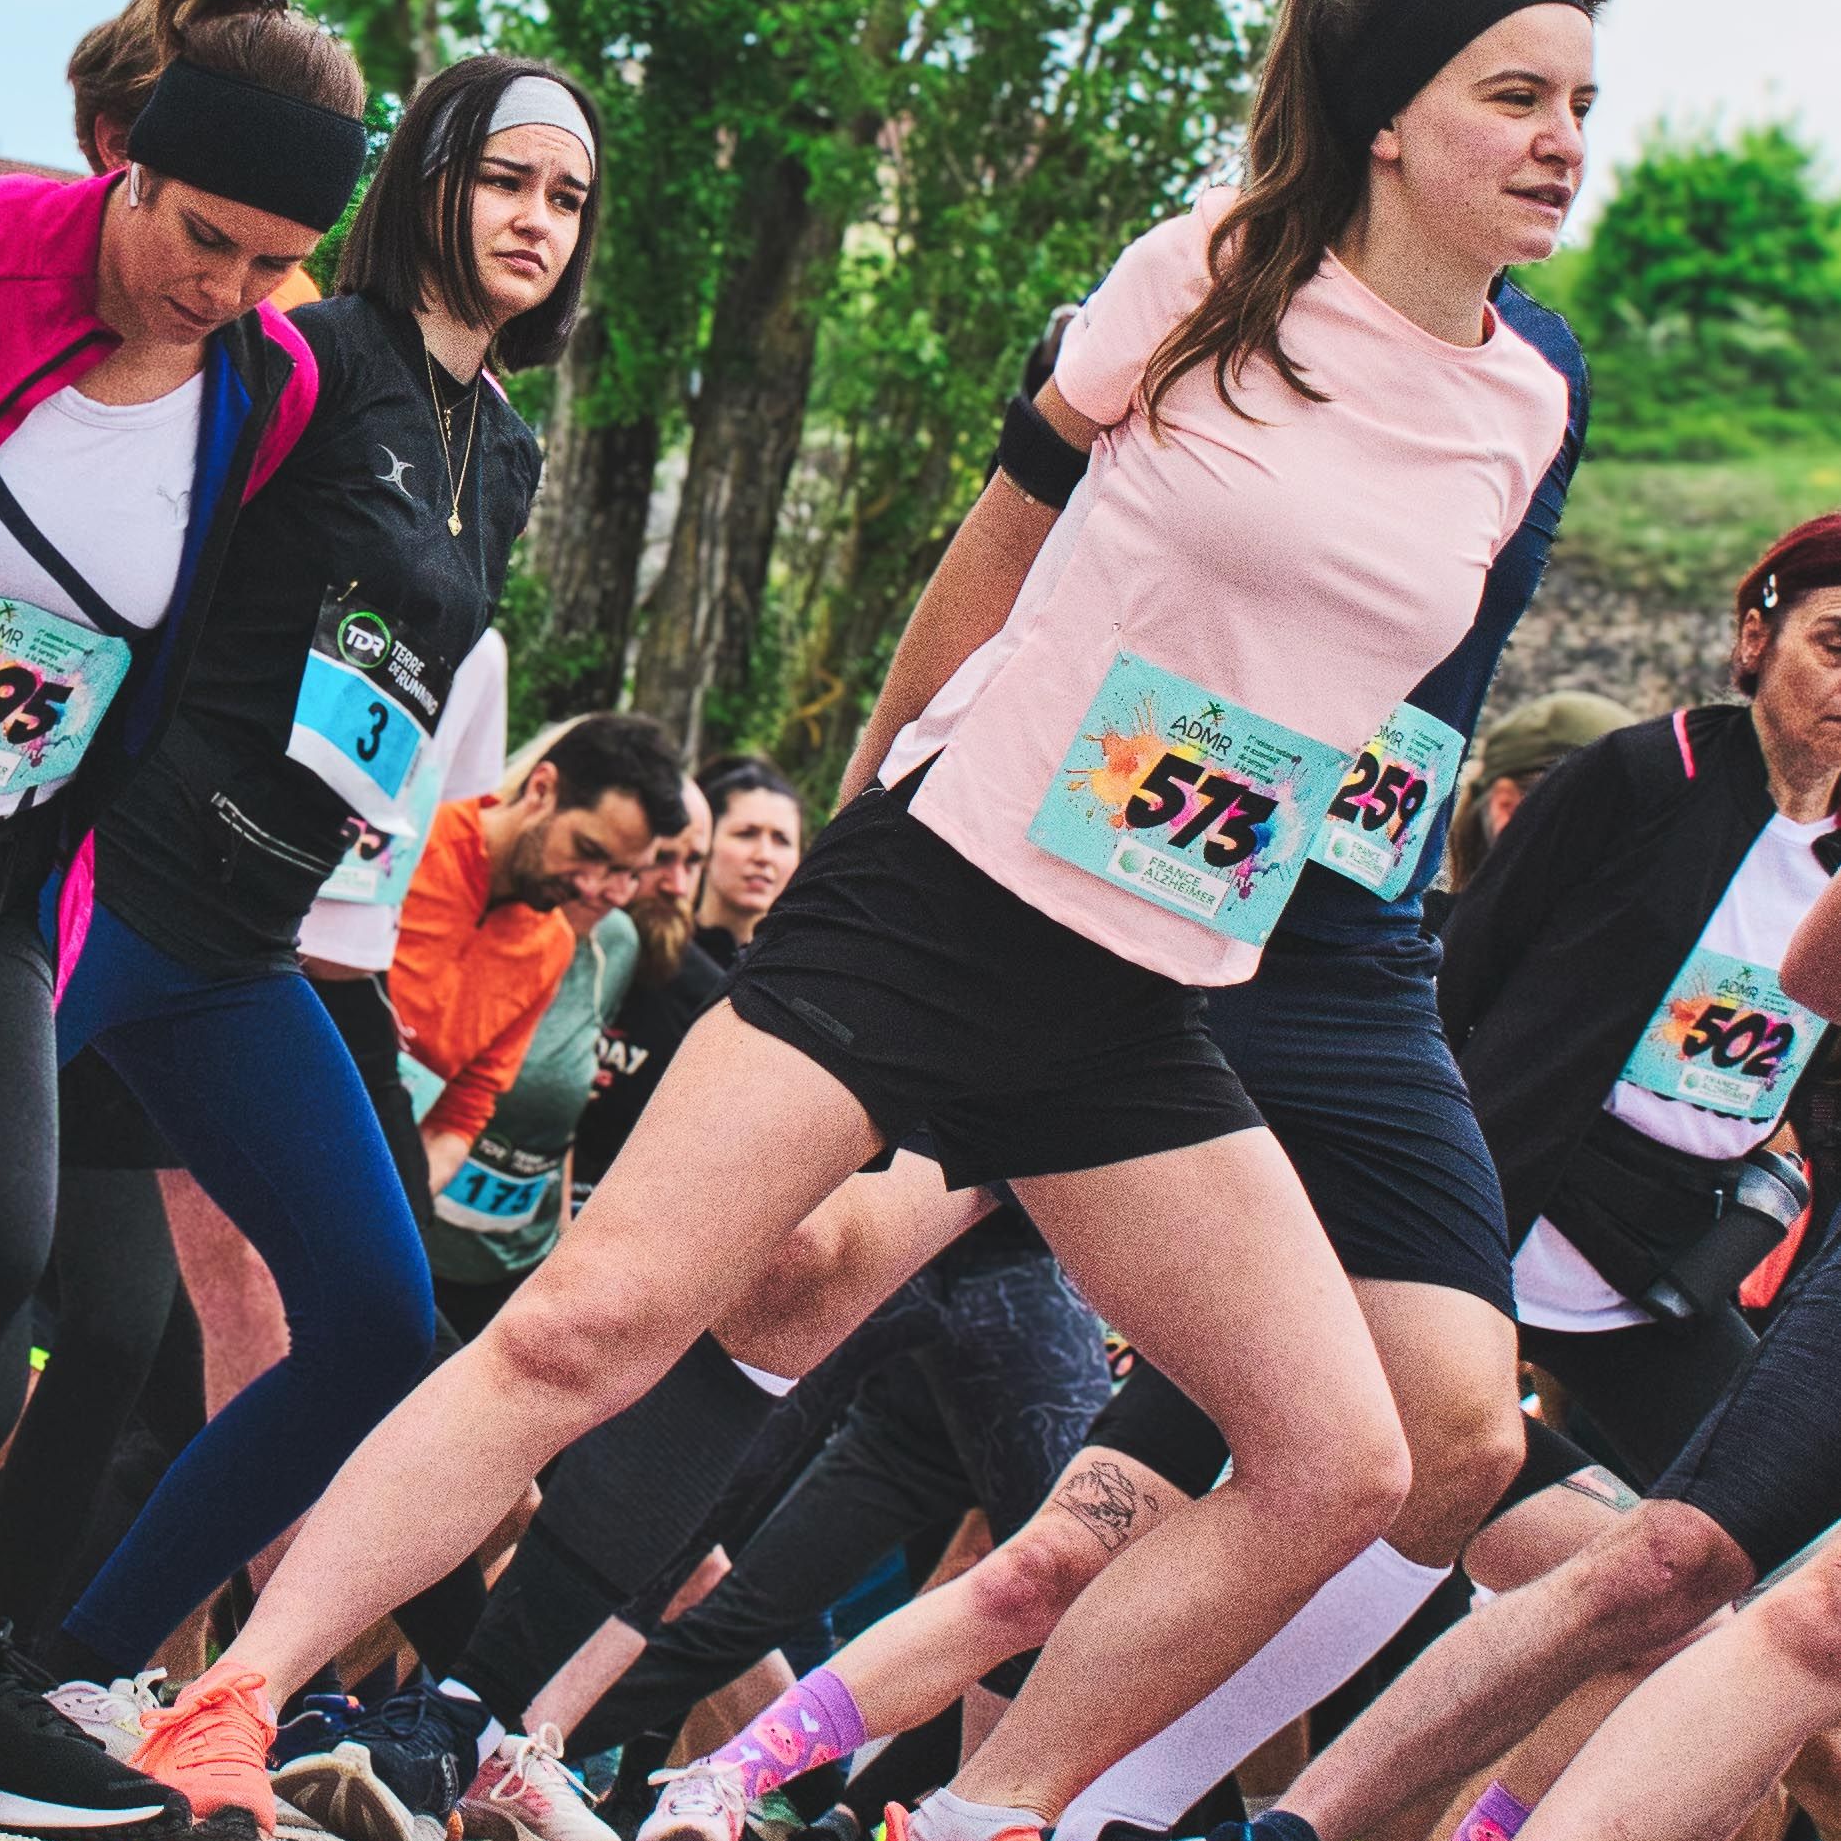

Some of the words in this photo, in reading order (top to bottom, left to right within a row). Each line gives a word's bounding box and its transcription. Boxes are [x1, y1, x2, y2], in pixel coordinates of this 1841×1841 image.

[345, 624, 386, 658] TDR
[391, 640, 426, 677] TERRE
[356, 701, 389, 762] 3
[1170, 714, 1233, 756] ADMR
[1326, 751, 1428, 844] 259
[1143, 867, 1217, 905] ALZHEIMER
[1149, 856, 1202, 888] FRANCE
[1682, 1004, 1794, 1078] 502
